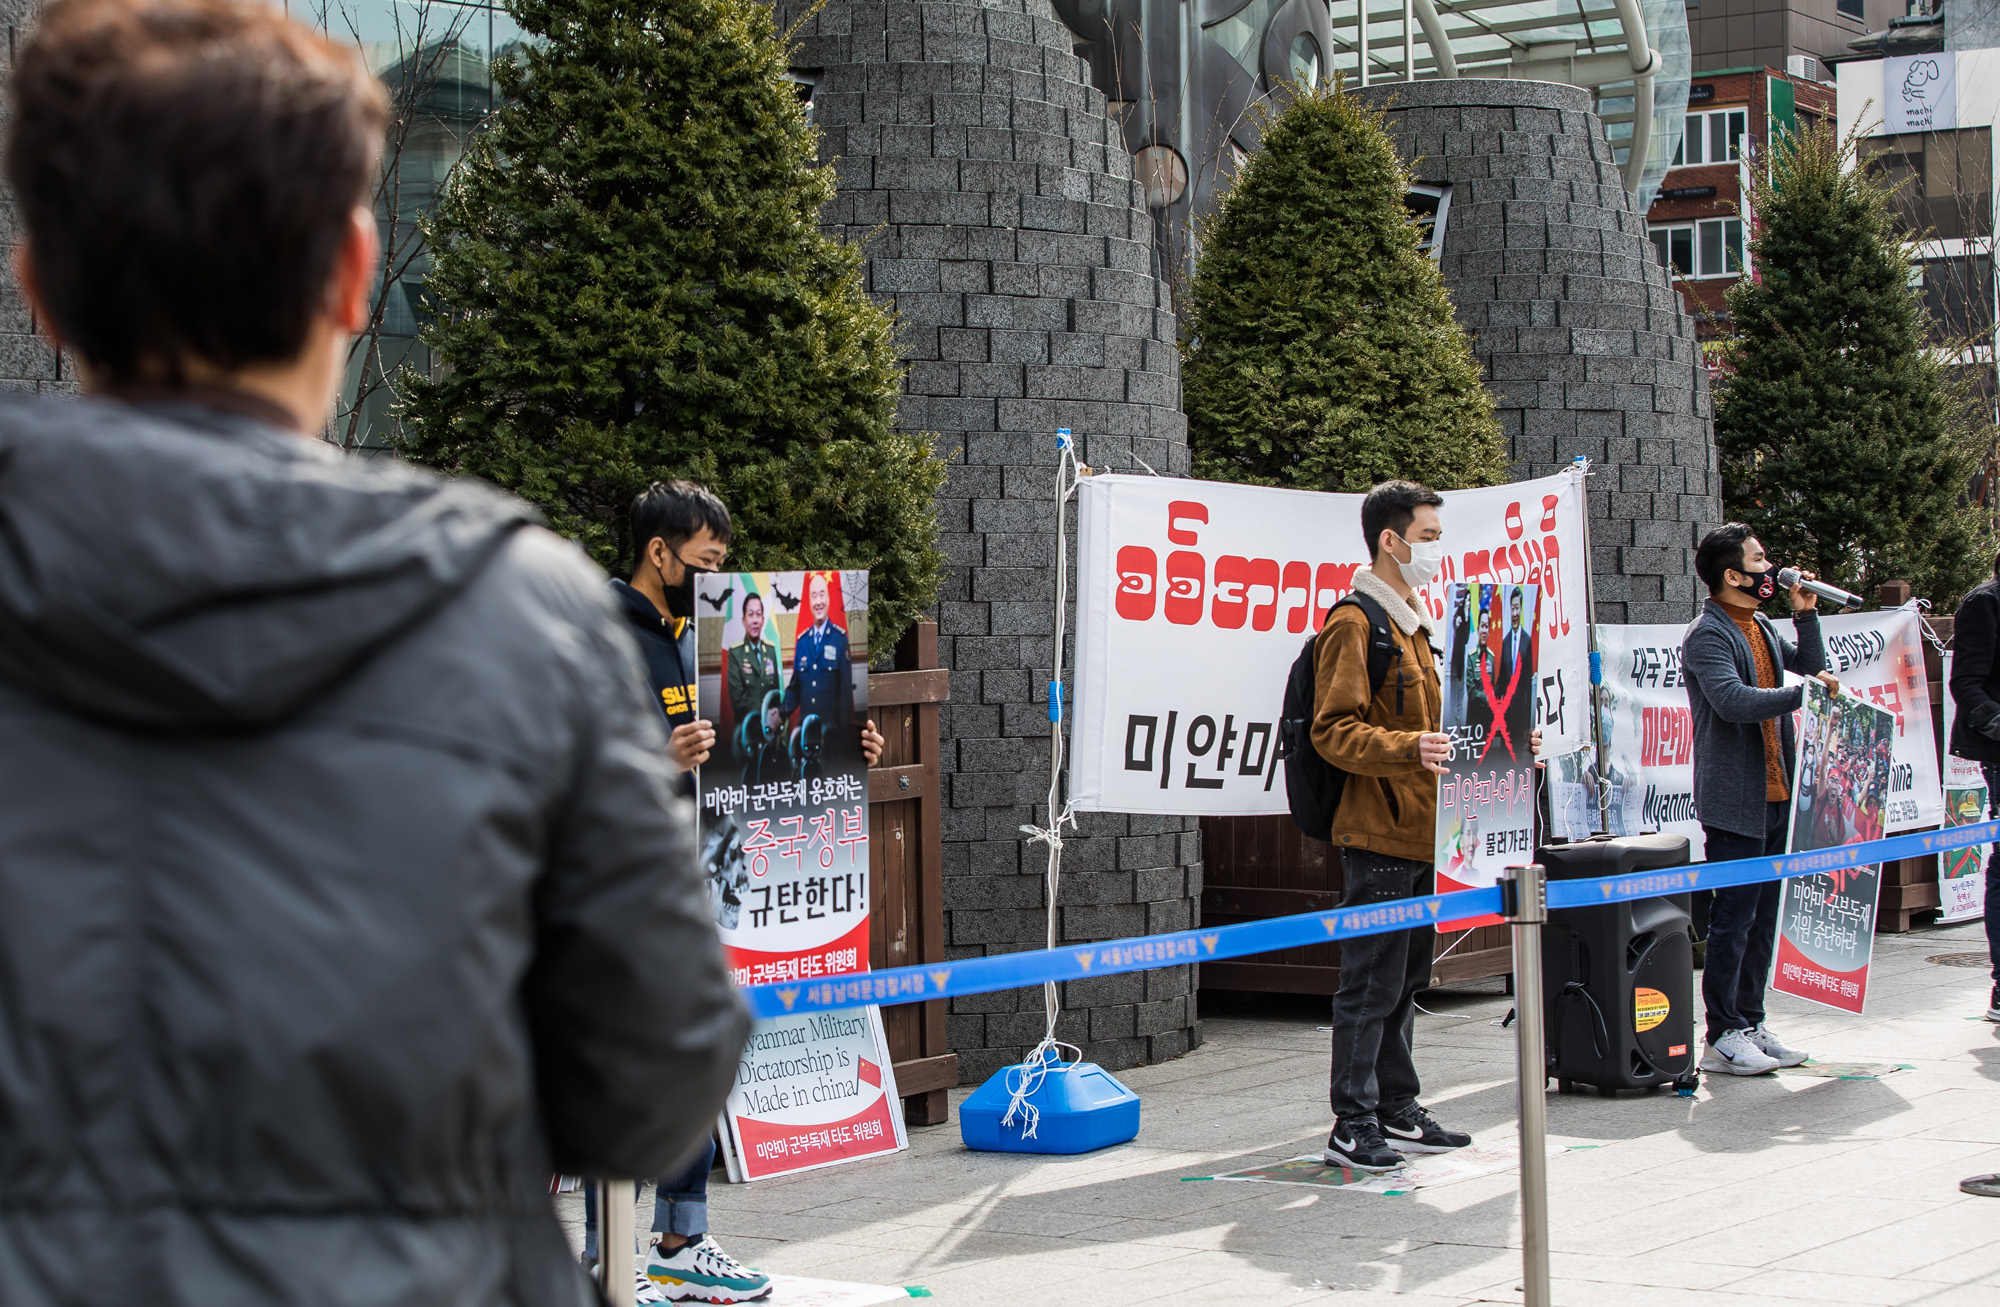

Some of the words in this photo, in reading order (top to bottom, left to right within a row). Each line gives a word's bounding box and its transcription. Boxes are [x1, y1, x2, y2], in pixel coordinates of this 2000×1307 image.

[1906, 105, 1932, 116] machi
[1906, 115, 1933, 127] machi
[705, 785, 750, 817] 미얀마
[751, 778, 807, 812] 군부독재
[809, 773, 863, 806] 옹호하는
[1442, 768, 1532, 825] 미얀마에서
[741, 805, 869, 879] 중국정부
[1486, 828, 1533, 857] 물러가라!
[749, 873, 865, 928] 규탄한다!
[1793, 880, 1827, 917] 미얀마
[1825, 893, 1872, 933] 군부독재
[1788, 911, 1812, 944] 지원
[1813, 919, 1858, 959] 중단하라
[753, 957, 799, 987] 군부독재
[800, 955, 824, 978] 타도
[824, 947, 857, 974] 위원회
[1782, 962, 1802, 981] 미얀마
[1801, 967, 1826, 990] 군부독재
[1826, 975, 1840, 993] 타도
[1840, 979, 1860, 1000] 위원회
[807, 973, 925, 1005] 서울남대문경찰서장
[808, 1013, 866, 1042] Military
[738, 1047, 834, 1085] Dictatorship
[836, 1046, 850, 1068] is
[742, 1085, 790, 1116] Made
[792, 1085, 810, 1107] in
[812, 1076, 857, 1103] china
[756, 1138, 788, 1160] 미얀마
[789, 1129, 832, 1155] 군부독재
[831, 1126, 853, 1146] 타도
[852, 1119, 883, 1141] 위원회
